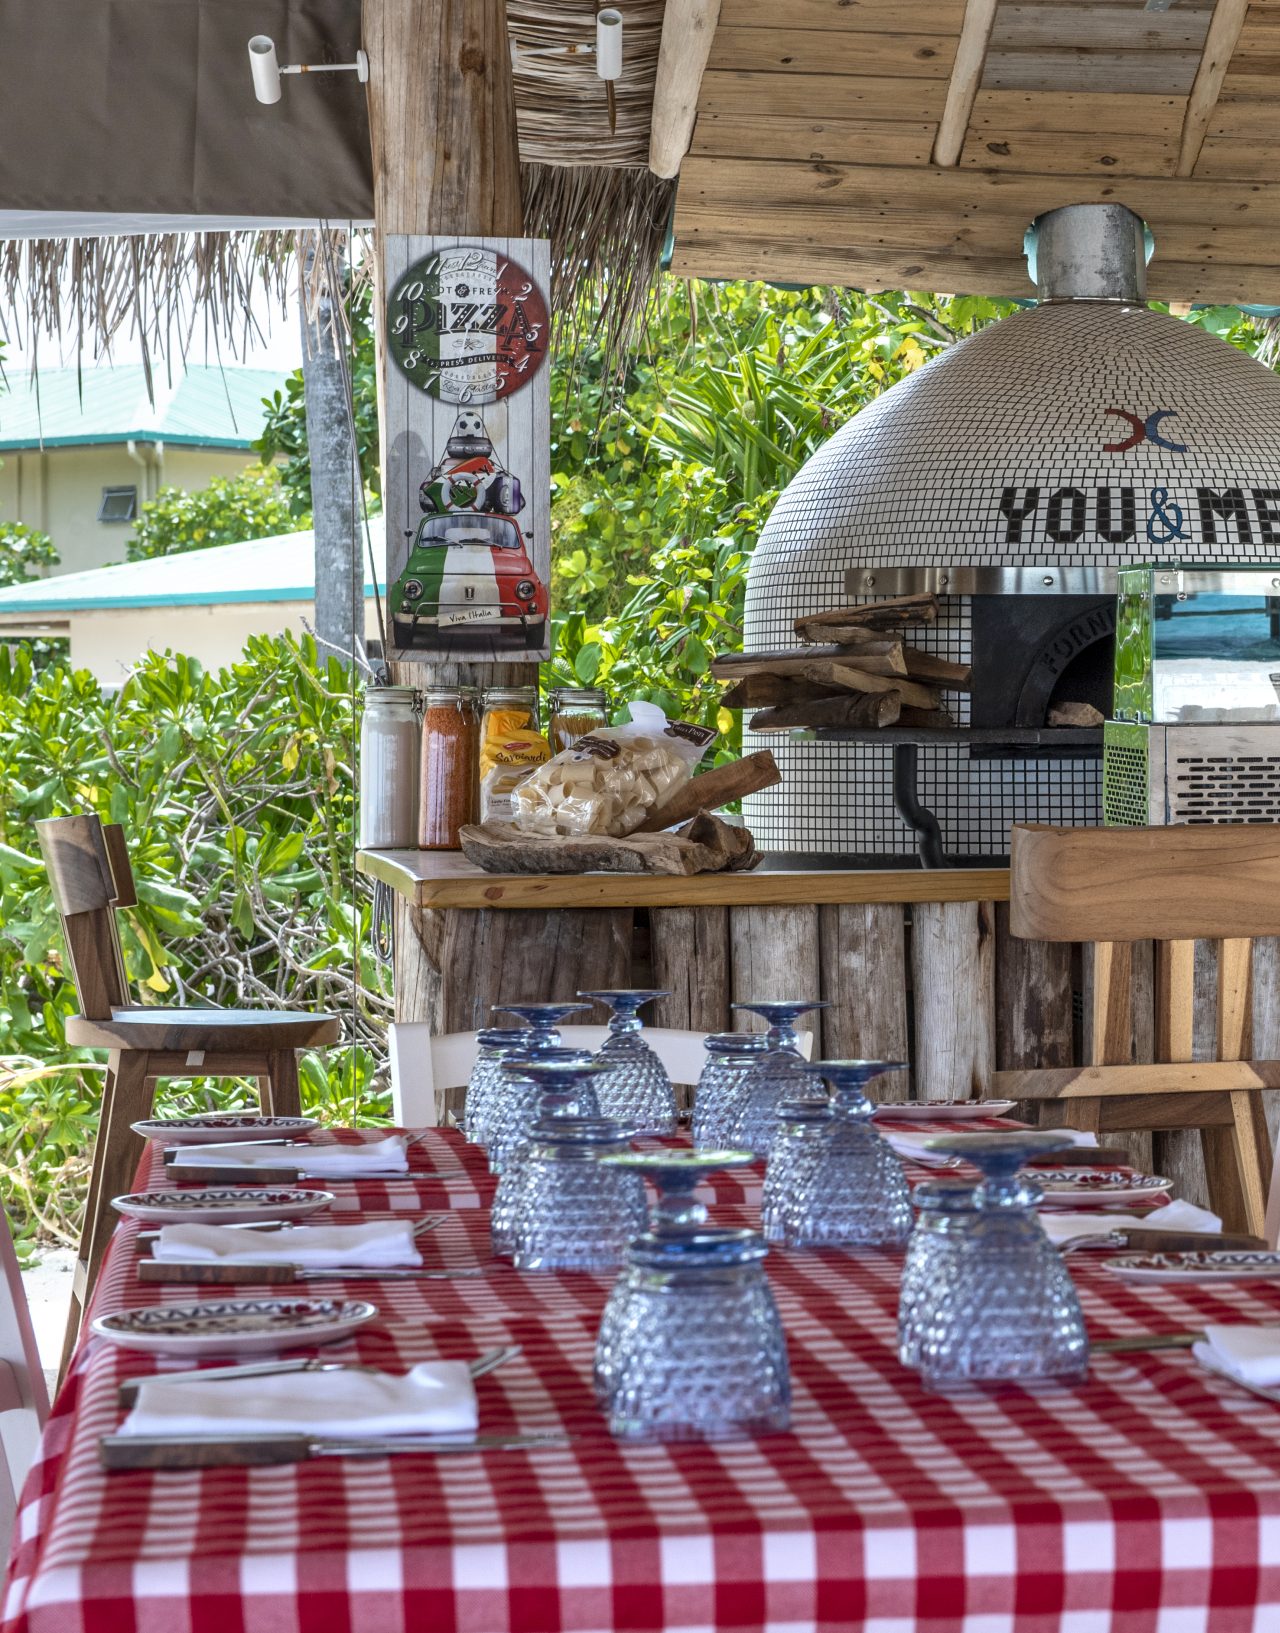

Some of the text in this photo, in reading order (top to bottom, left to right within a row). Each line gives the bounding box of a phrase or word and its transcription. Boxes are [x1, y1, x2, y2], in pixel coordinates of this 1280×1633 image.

[425, 257, 448, 275] 11
[460, 251, 483, 271] 12
[496, 262, 508, 280] 1
[397, 282, 423, 301] 10
[512, 282, 532, 301] 2
[392, 315, 408, 335] 9
[398, 297, 542, 352] PIZZA
[526, 323, 542, 341] 3
[404, 350, 420, 369] 8
[514, 354, 531, 372] 4
[424, 370, 440, 389] 7
[495, 371, 509, 390] 5
[459, 384, 472, 403] 6
[449, 613, 466, 622] Viva
[495, 751, 546, 763] Savoiardi
